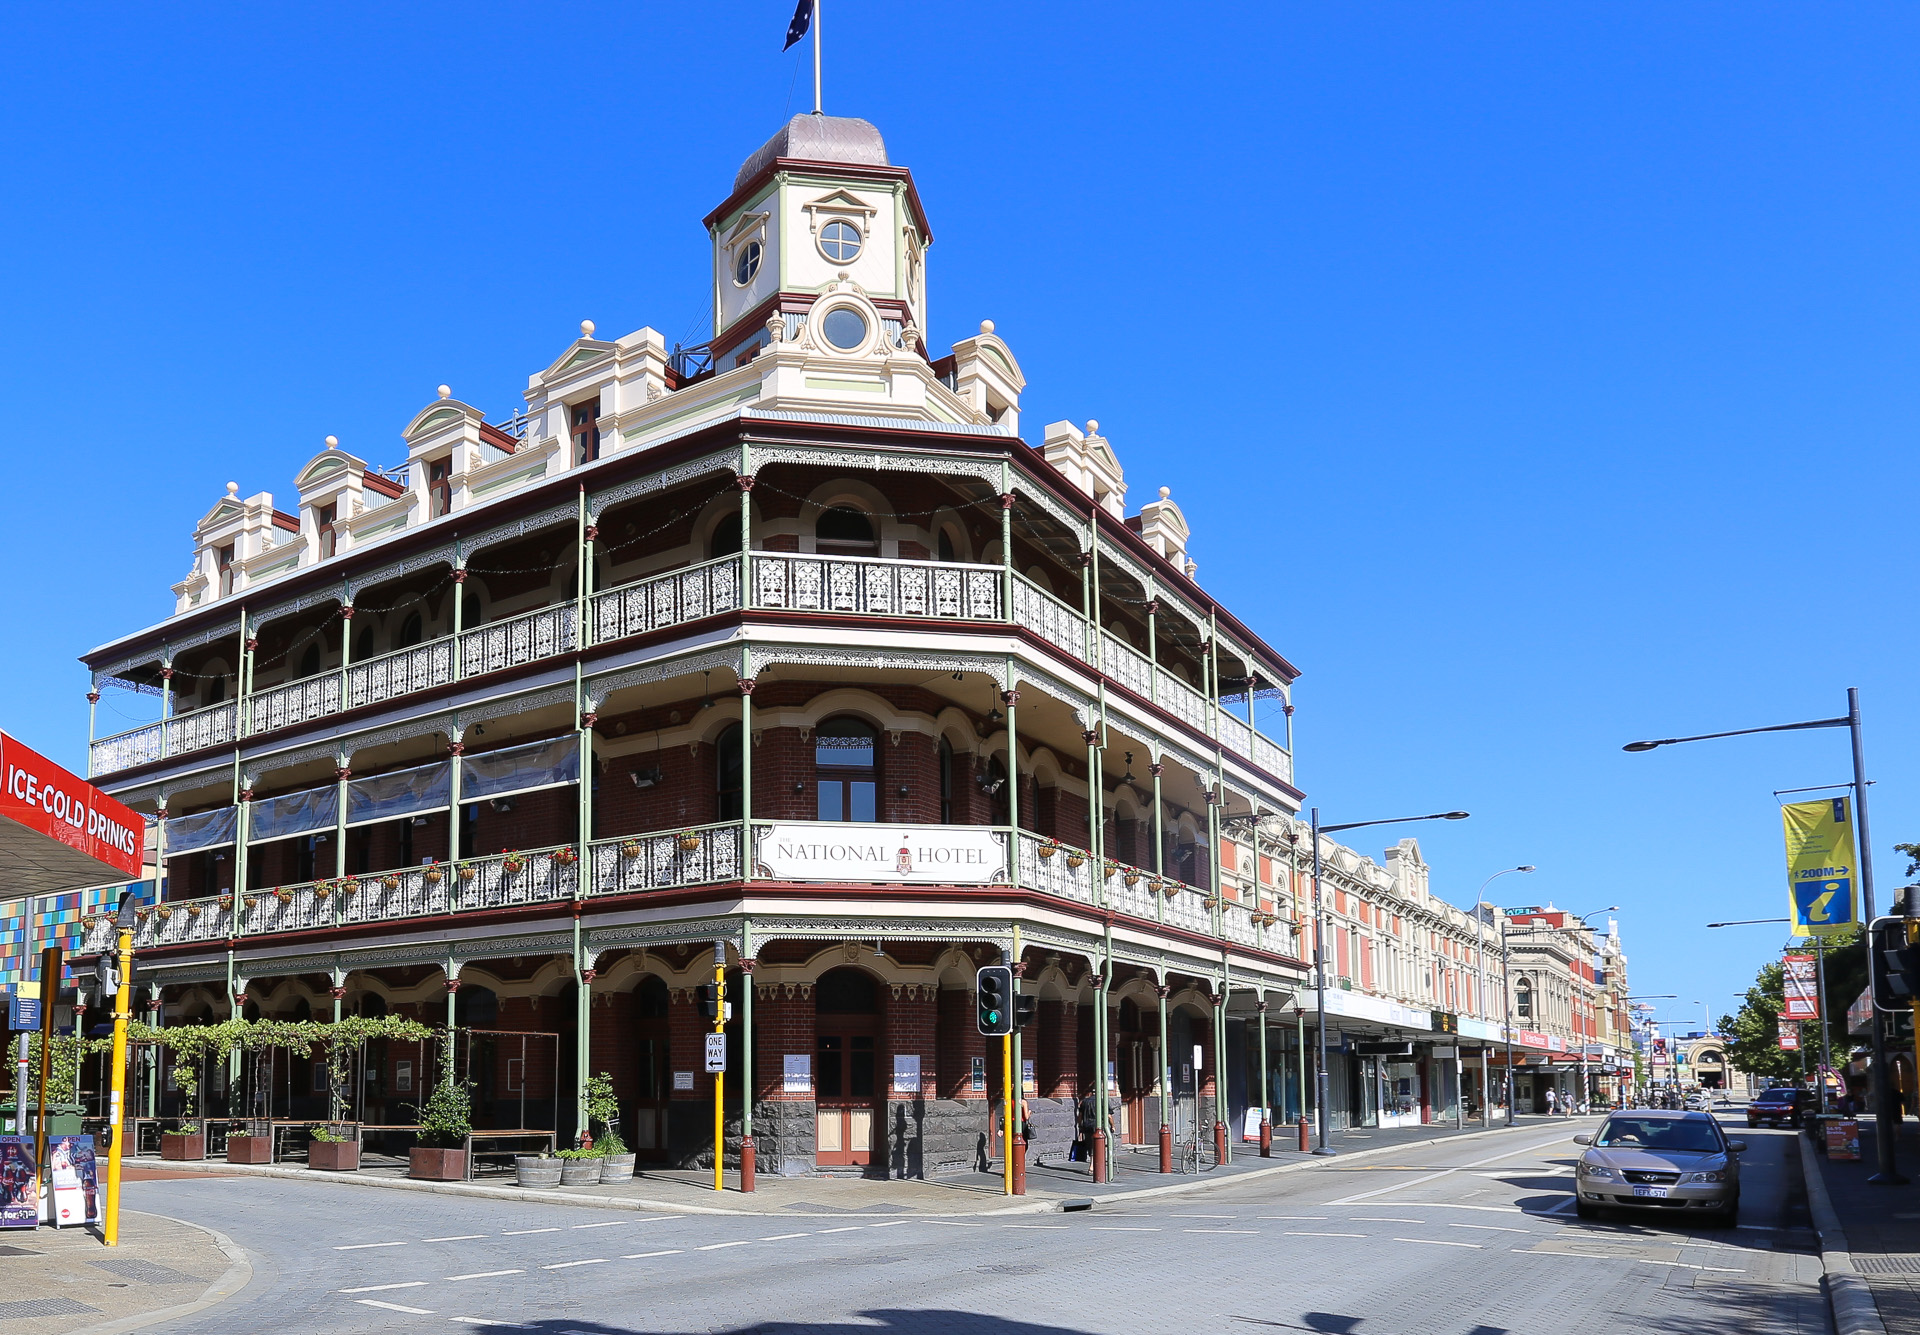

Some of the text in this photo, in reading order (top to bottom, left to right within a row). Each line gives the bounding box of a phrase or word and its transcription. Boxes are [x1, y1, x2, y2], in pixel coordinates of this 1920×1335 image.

[8, 764, 135, 855] ICE-COLD DRINKS
[778, 843, 989, 864] NATIONAL HOTEL
[1801, 867, 1835, 878] 200M
[708, 1036, 722, 1045] ONE
[708, 1048, 722, 1057] WAY
